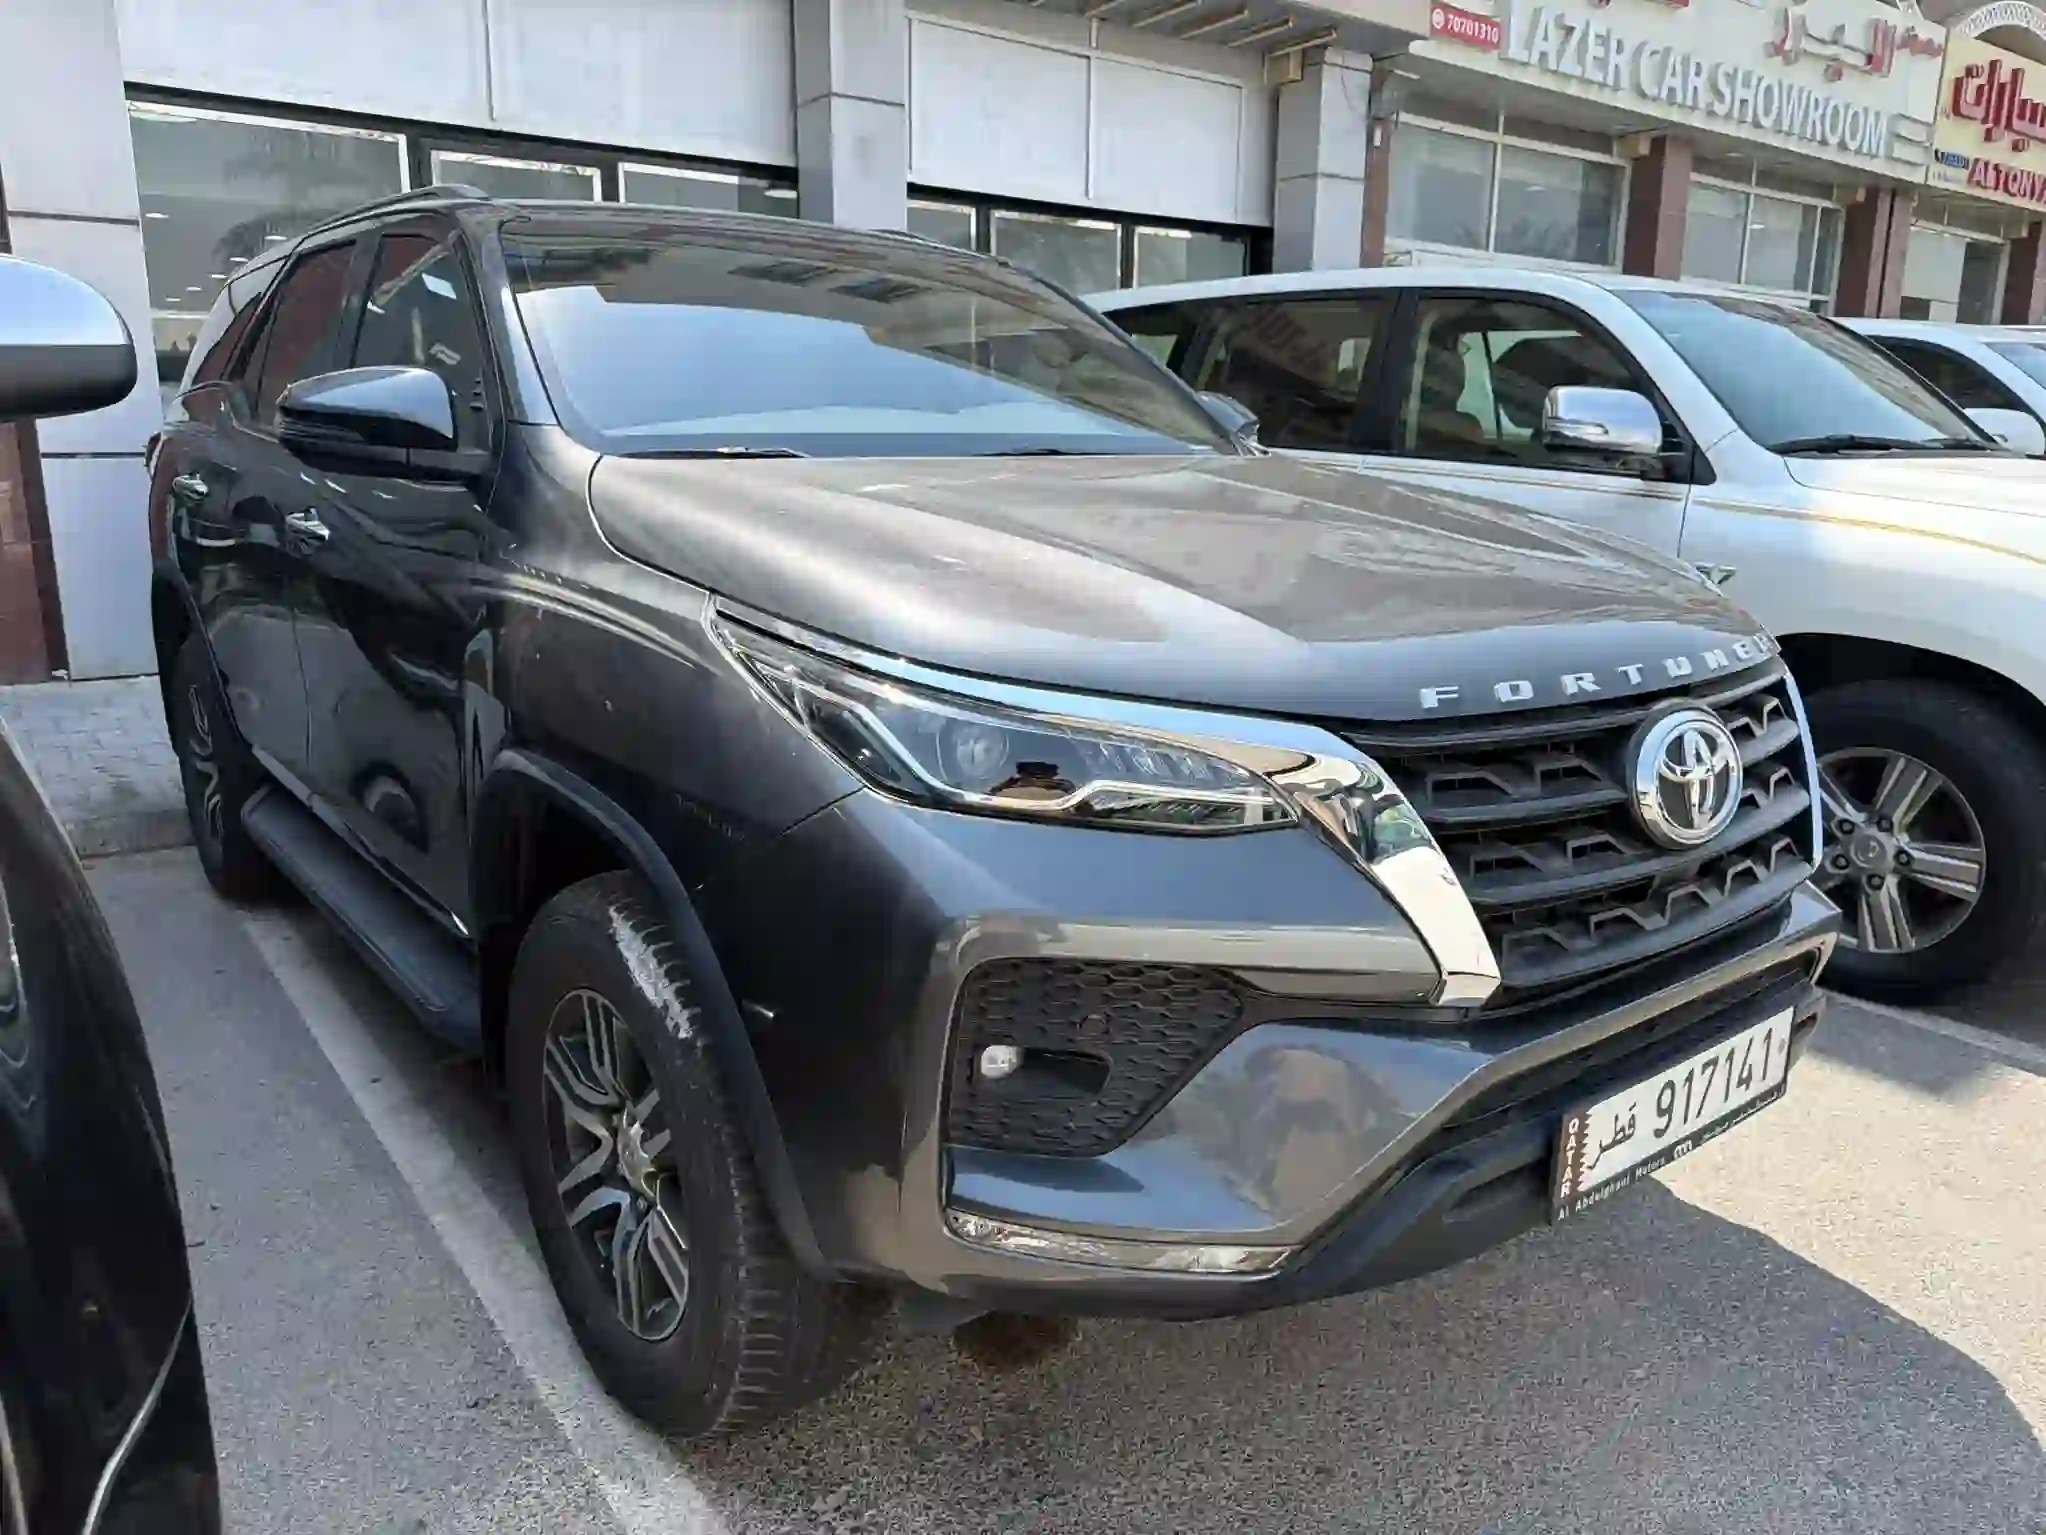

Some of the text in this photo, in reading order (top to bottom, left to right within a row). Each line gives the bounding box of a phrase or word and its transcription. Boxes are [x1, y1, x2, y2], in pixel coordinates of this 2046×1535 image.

[1447, 13, 1499, 44] 70701310
[1507, 2, 1889, 158] LAZER CAR SHOWROOM
[1419, 633, 1774, 709] FORTUNER
[1652, 1026, 1774, 1139] 917141
[1560, 1117, 1580, 1200] QATAR
[1584, 1101, 1637, 1169] قطر
